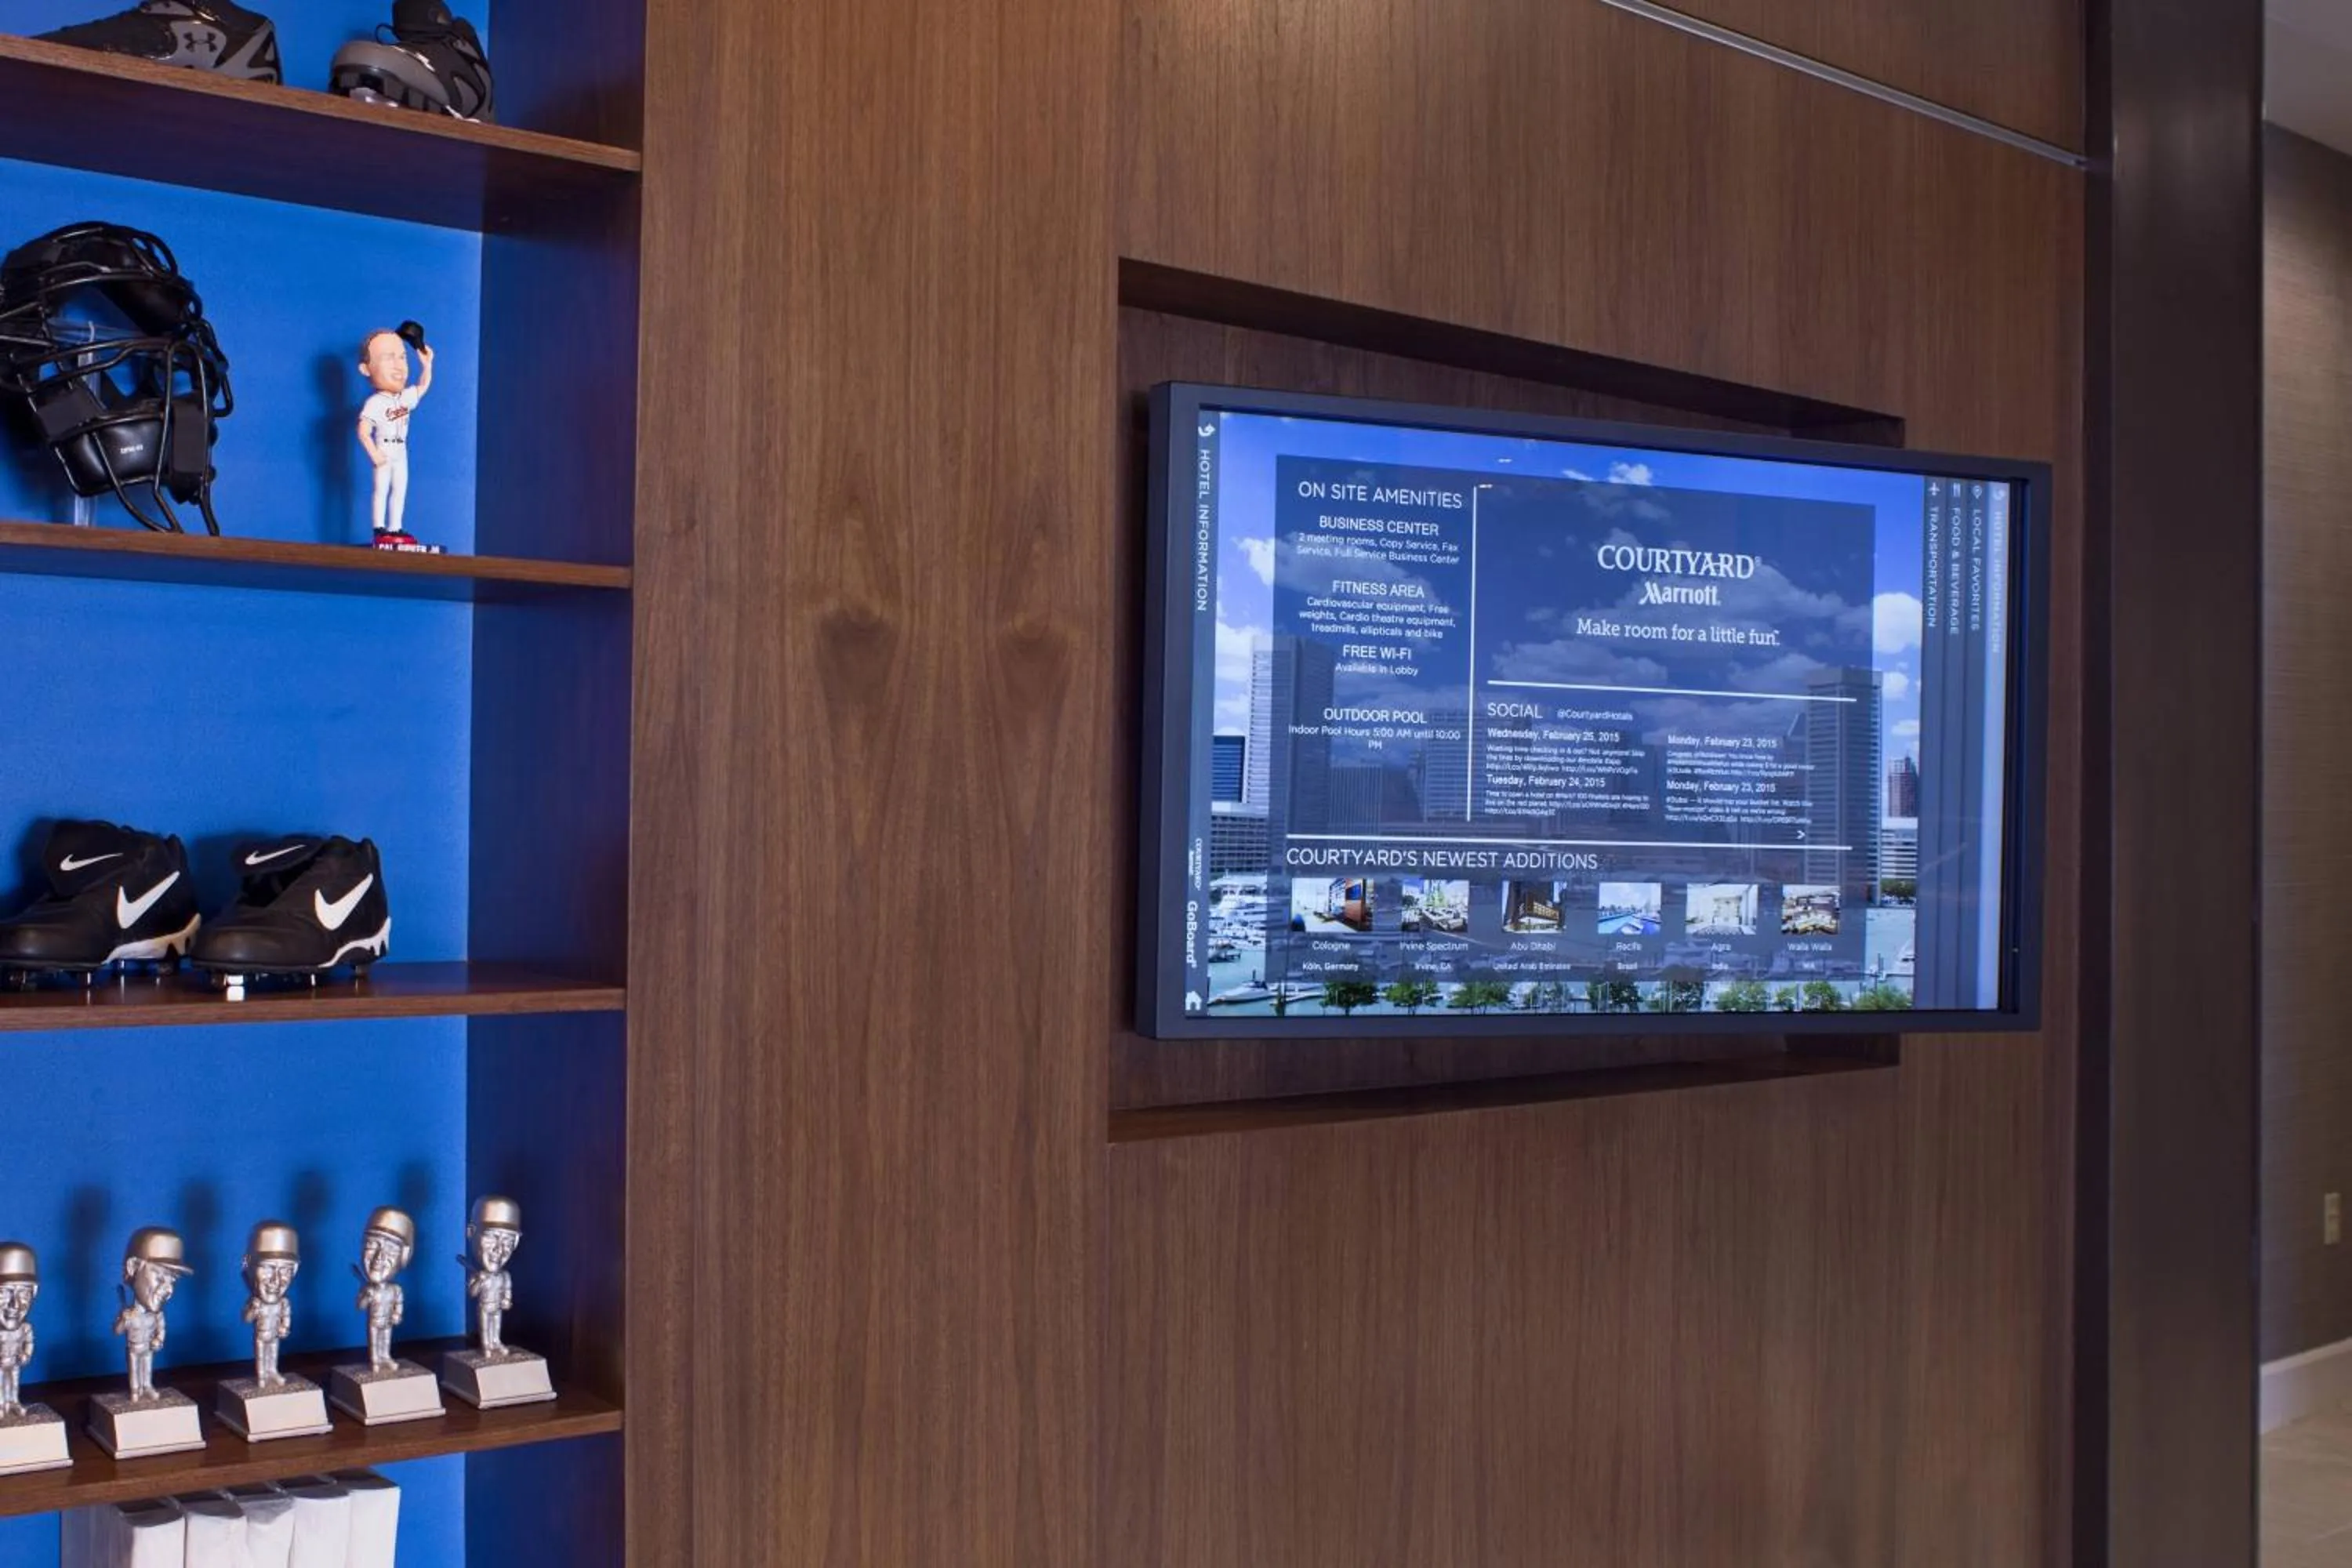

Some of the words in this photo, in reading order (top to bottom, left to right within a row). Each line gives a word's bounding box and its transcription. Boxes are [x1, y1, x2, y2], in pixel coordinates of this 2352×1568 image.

[1198, 449, 1210, 499] HOTEL
[1298, 481, 1326, 499] ON
[1330, 484, 1367, 502] SITE
[1373, 487, 1462, 509] AMENITIES
[1319, 515, 1384, 532] BUSINESS
[1387, 520, 1439, 536] CENTER
[1951, 507, 1962, 546] FOOD
[1972, 509, 1982, 553] LOCAL
[1298, 532, 1305, 542] 2
[1307, 533, 1344, 546] meeting
[1379, 538, 1403, 550] Copy
[1442, 541, 1458, 551] Fax
[1197, 504, 1209, 612] INFORMATION
[1354, 548, 1387, 560] Service
[1388, 551, 1428, 563] Business
[1429, 554, 1460, 564] Center
[1597, 544, 1755, 579] COURTYARD
[1926, 506, 1939, 628] TRANSPORTATION
[1333, 579, 1387, 596] FITNESS
[1389, 584, 1425, 599] AREA
[1639, 581, 1719, 607] Marriott
[1971, 557, 1982, 631] FAVORITES
[1307, 597, 1374, 610] Cardiovascular
[1428, 604, 1450, 615] Free
[1950, 563, 1961, 635] BEVERAGE
[1299, 610, 1337, 622] weights,
[1339, 611, 1370, 622] Cardio
[1372, 613, 1404, 624] theatre
[1406, 616, 1456, 629] equipment,
[1405, 627, 1421, 638] and
[1424, 628, 1443, 639] bike
[1577, 617, 1620, 637] Make
[1624, 624, 1668, 639] room
[1671, 624, 1694, 641] for
[1697, 630, 1706, 642] a
[1710, 626, 1744, 644] little
[1342, 644, 1377, 659] FREE
[1380, 647, 1413, 661] WI-FI
[1390, 665, 1418, 677] Lobby
[1323, 707, 1389, 723] OUTDOOR
[1392, 710, 1427, 724] POOL
[1487, 702, 1543, 719] SOCIAL
[1288, 724, 1318, 735] Indoor
[1322, 725, 1341, 735] Pool
[1344, 726, 1370, 737] Hours
[1396, 728, 1411, 739] AM
[1414, 729, 1433, 739] until
[1487, 728, 1541, 741] Wednesday,
[1543, 730, 1581, 743] February
[1599, 731, 1621, 743] 2015
[1368, 739, 1382, 750] PM
[1704, 735, 1740, 750] February
[1486, 774, 1526, 788] Tuesday,
[1528, 775, 1567, 789] February
[1584, 777, 1606, 788] 2015
[1667, 780, 1702, 793] Monday,
[1704, 780, 1740, 795] February
[1287, 847, 1417, 866] COURTYARD'S
[1423, 851, 1499, 869] NEWEST
[1503, 852, 1598, 871] ADDITIONS
[1185, 901, 1198, 965] GoBoard
[1312, 940, 1351, 953] Cologne
[1399, 941, 1425, 951] Irvine
[1426, 941, 1468, 952] Spectrum
[1511, 942, 1528, 951] Abu
[1530, 942, 1556, 951] Dhabi
[1711, 942, 1731, 953] Agra
[1324, 961, 1359, 972] Germany
